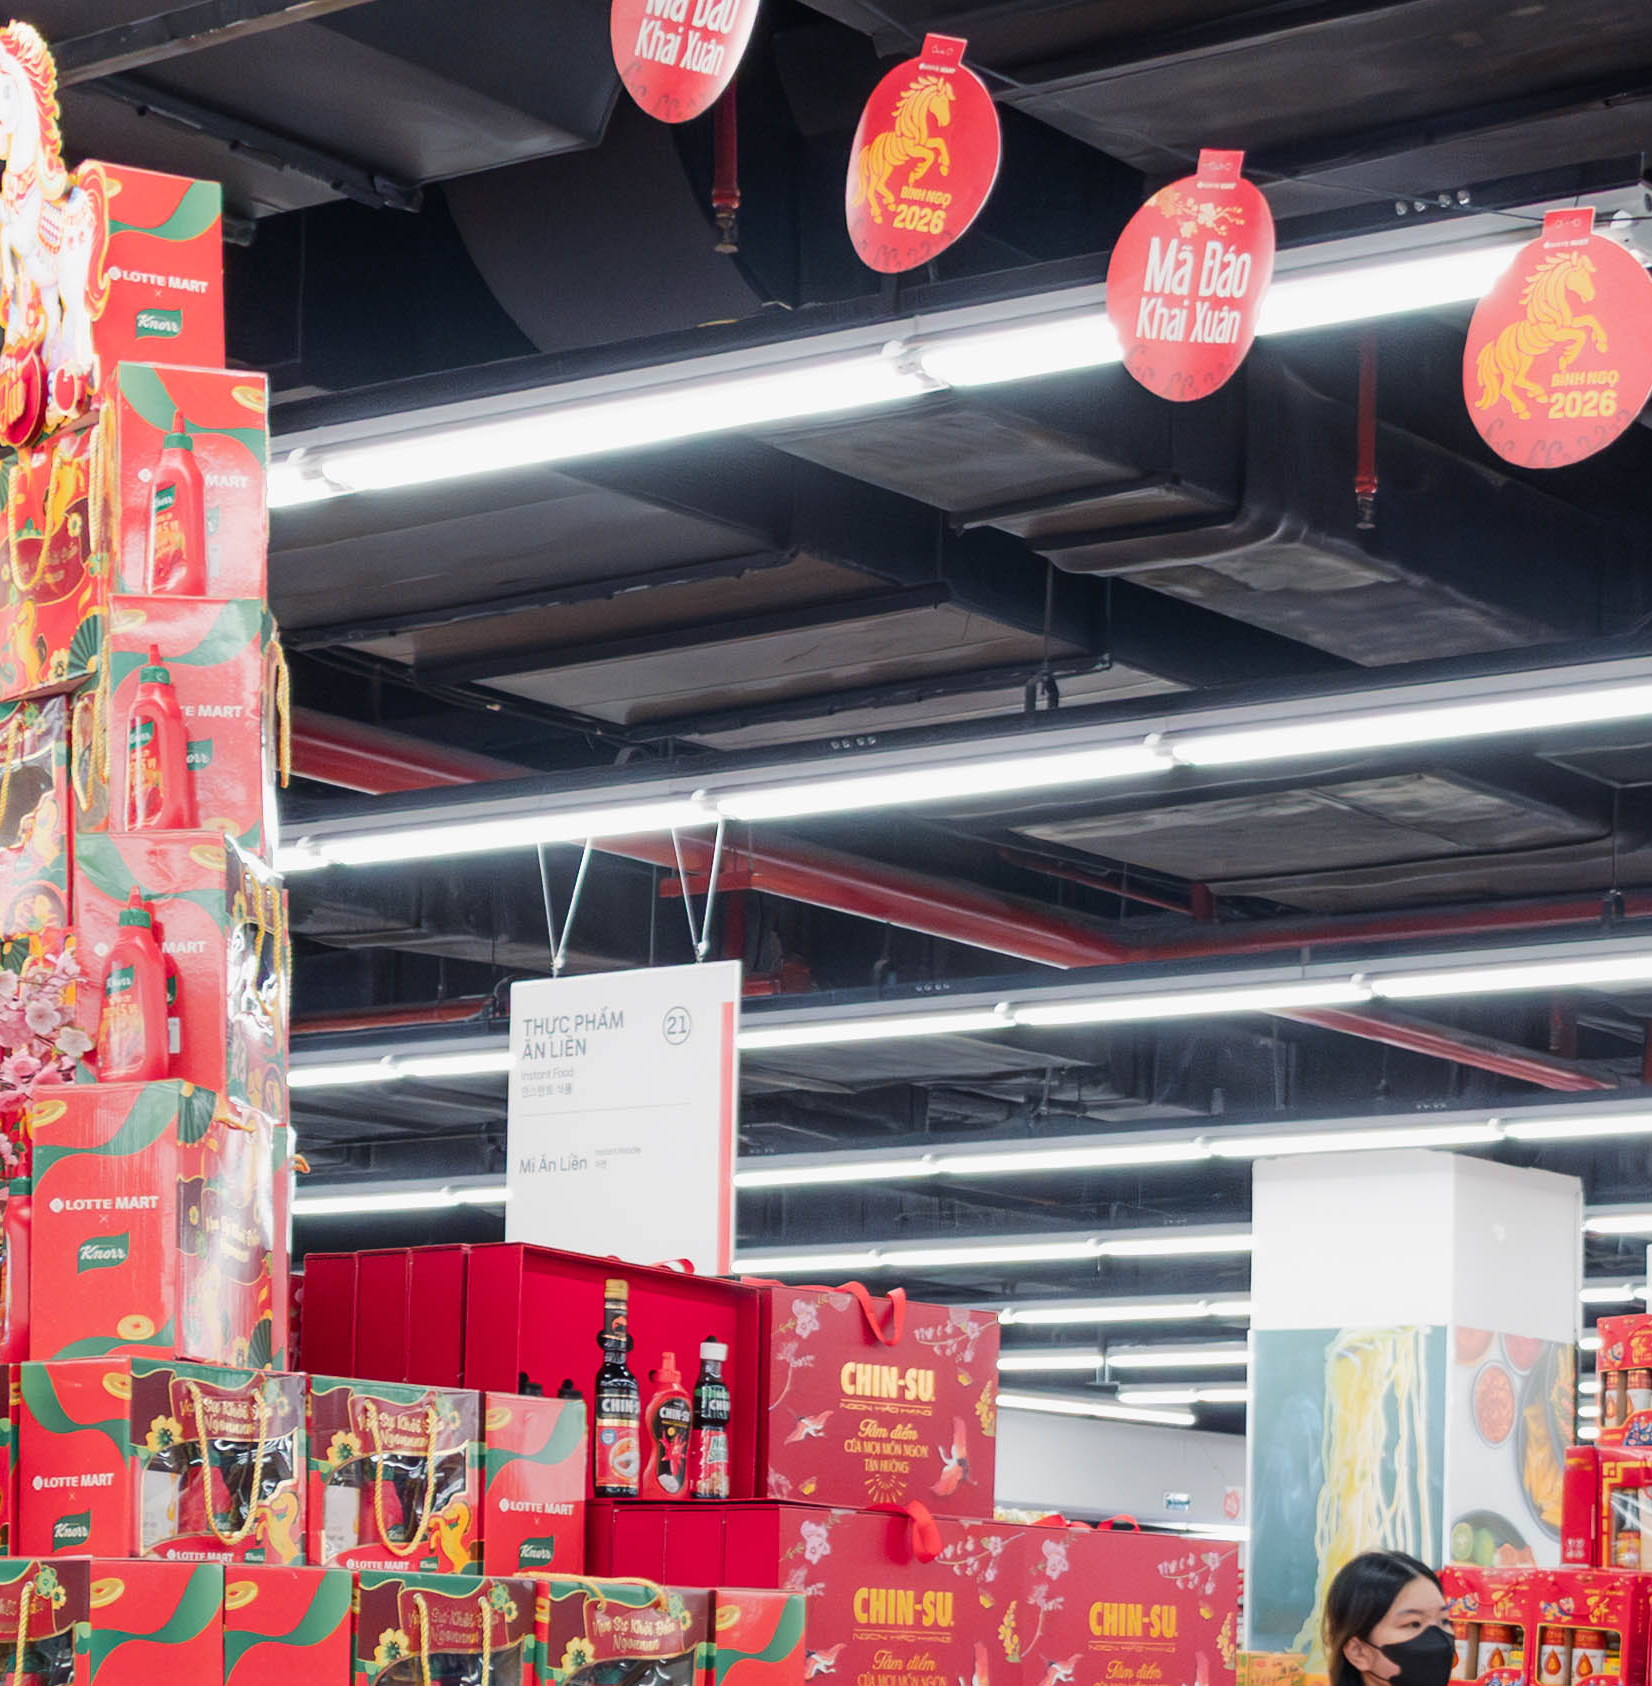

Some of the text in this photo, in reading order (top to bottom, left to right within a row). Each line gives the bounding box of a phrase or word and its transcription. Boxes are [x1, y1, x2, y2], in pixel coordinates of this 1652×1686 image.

[634, 18, 726, 78] Khai Xuân
[893, 203, 946, 235] 2026
[1144, 237, 1251, 298] Mã Đáo
[1136, 297, 1241, 343] Khai Xuân
[1549, 390, 1616, 418] 2026
[667, 1016, 686, 1035] 21
[841, 1362, 934, 1401] CHIN-SU
[854, 1588, 953, 1626] CHIN-SU
[1090, 1602, 1177, 1637] CHIN-SU
